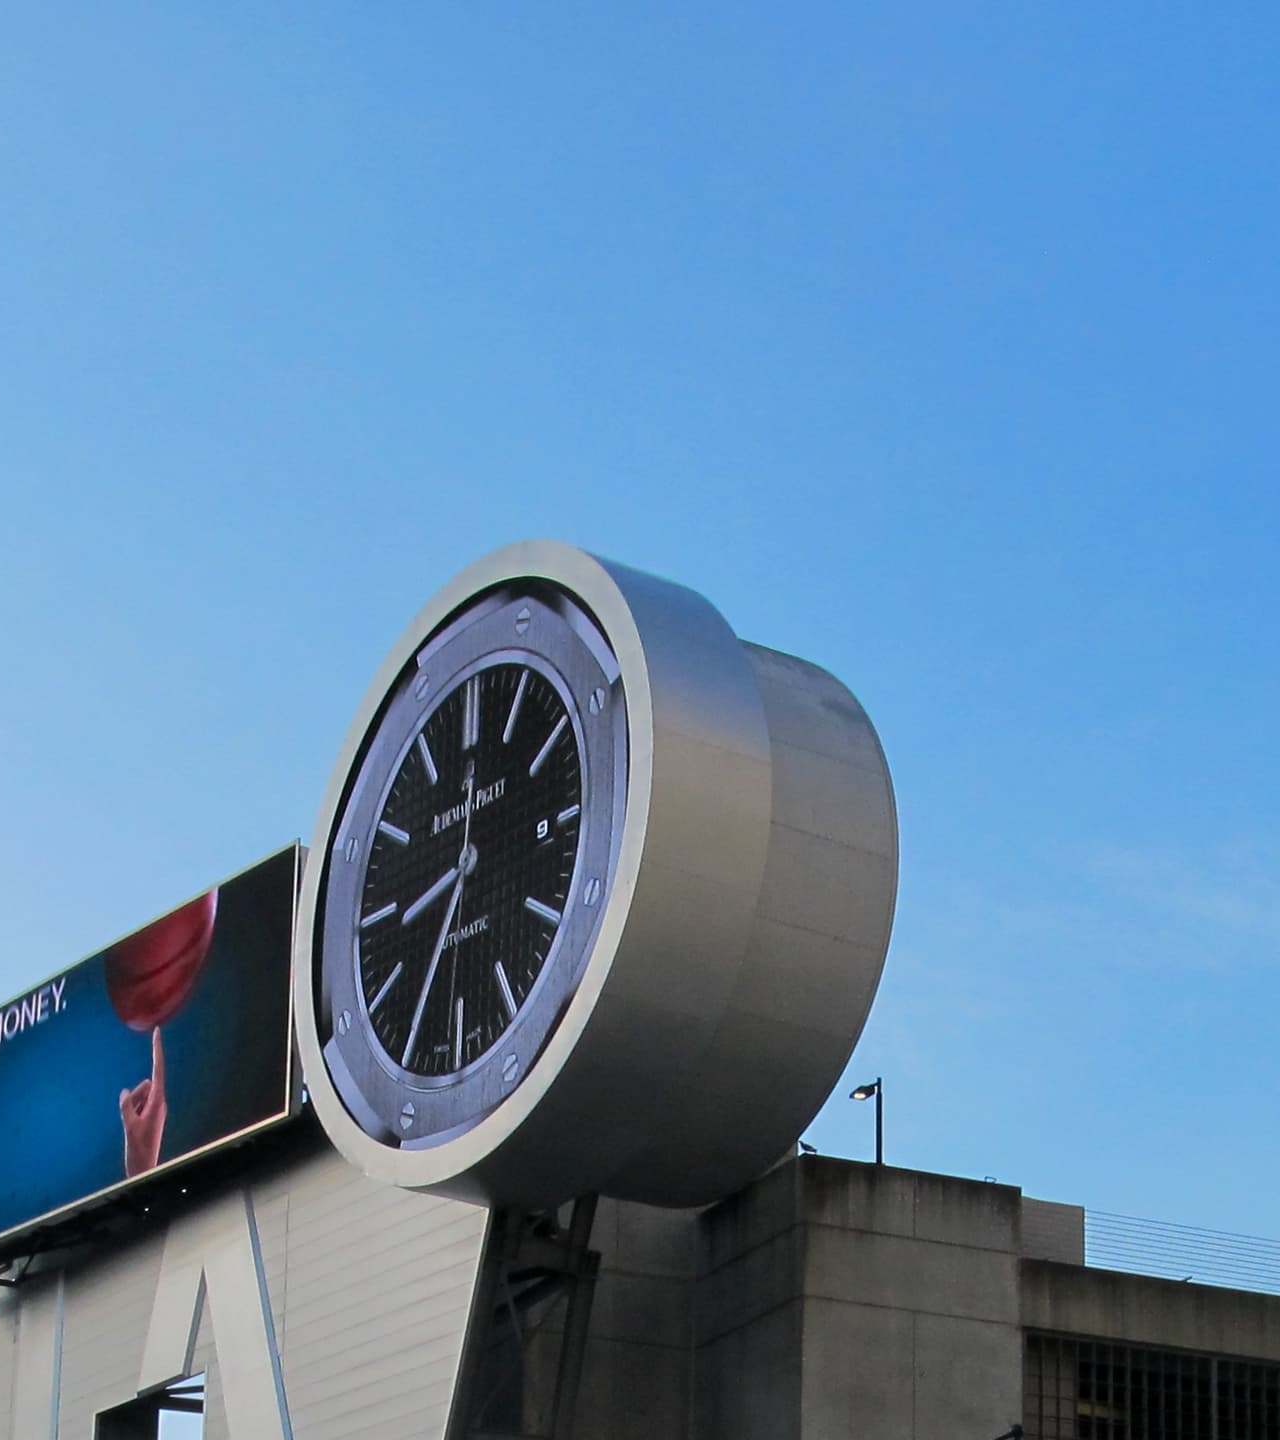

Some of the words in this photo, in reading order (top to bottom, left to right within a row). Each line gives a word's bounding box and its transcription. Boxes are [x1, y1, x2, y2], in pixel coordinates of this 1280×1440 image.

[475, 778, 506, 811] PIGUET
[536, 818, 549, 839] 9
[440, 914, 489, 950] UTOMATIC
